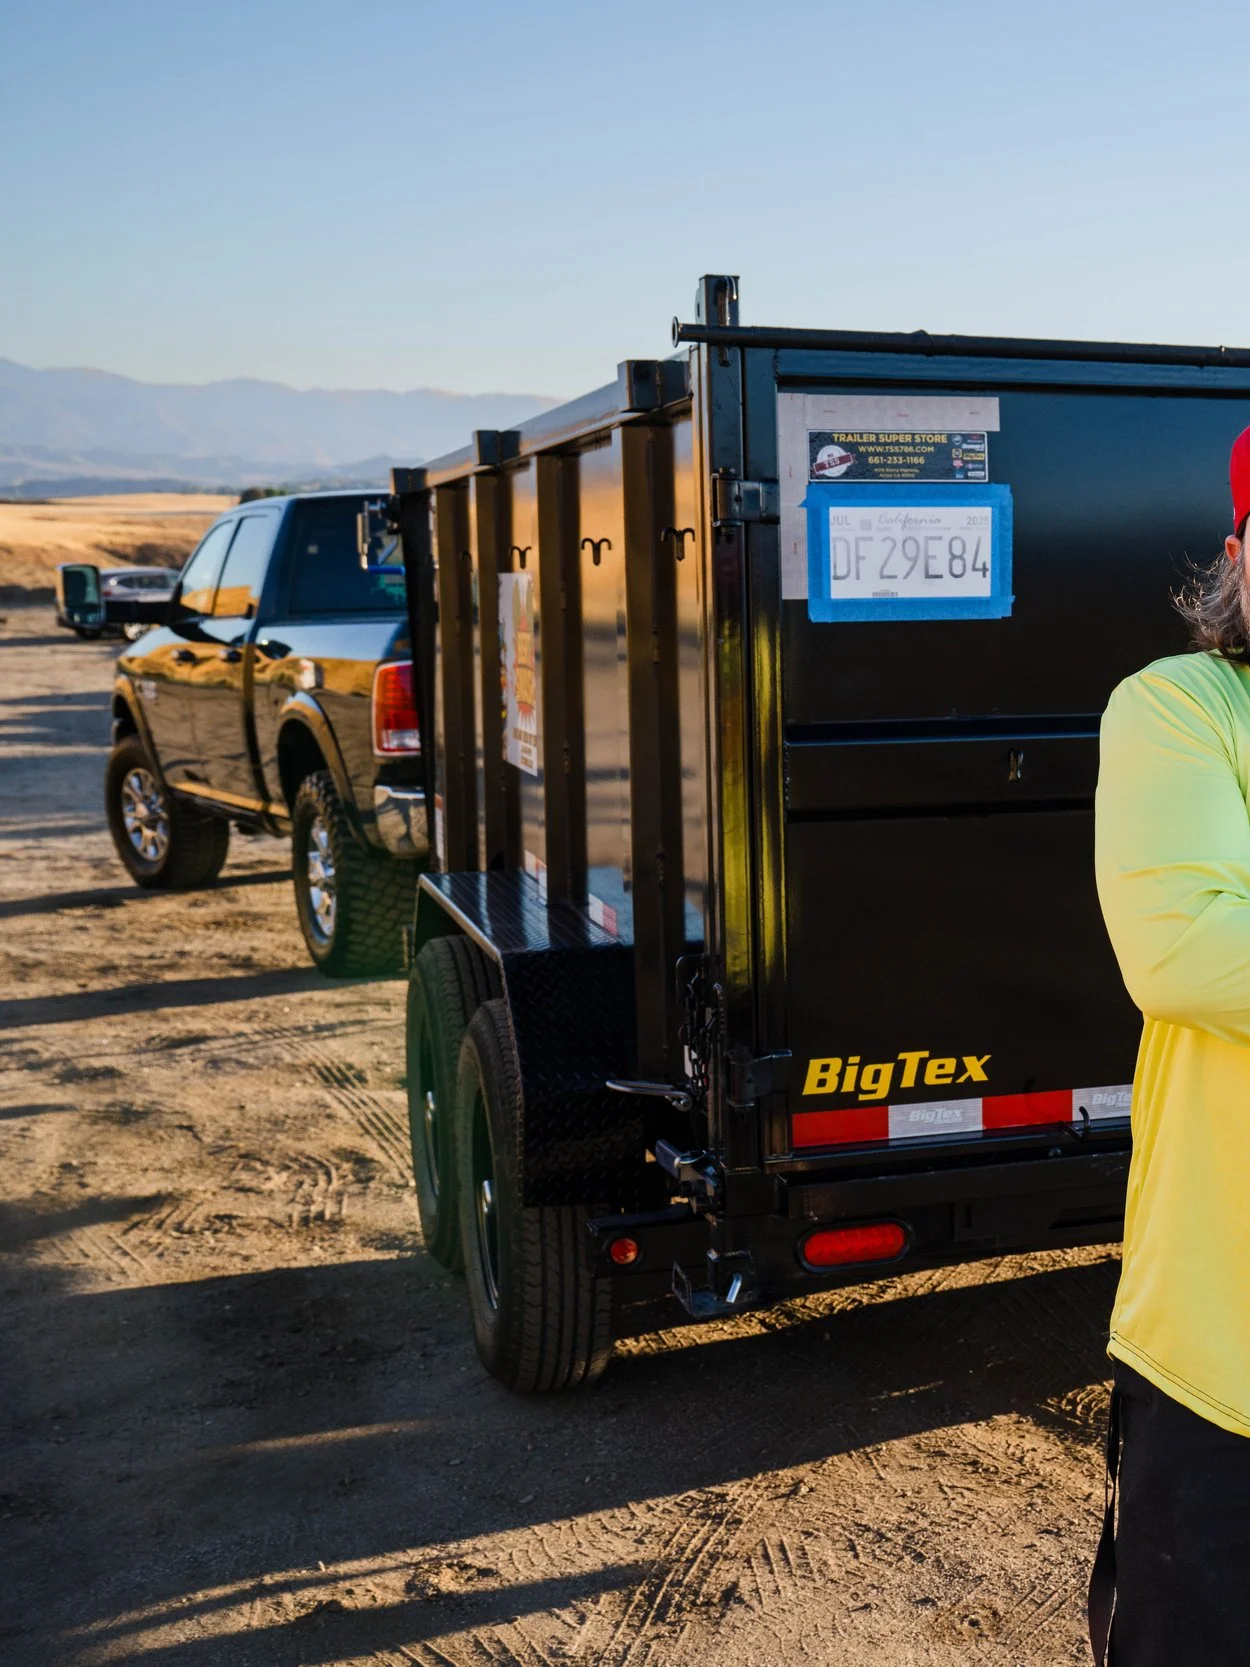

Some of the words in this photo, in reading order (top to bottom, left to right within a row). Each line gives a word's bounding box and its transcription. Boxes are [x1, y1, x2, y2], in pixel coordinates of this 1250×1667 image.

[832, 433, 876, 443] TRAILER
[879, 434, 912, 443] SUPER
[915, 434, 948, 443] STORE
[858, 445, 934, 453] WWW.TSS786.COM
[823, 457, 841, 468] TSS
[868, 456, 925, 464] 661-233-1166
[832, 515, 851, 526] JUL
[878, 511, 942, 531] California
[832, 535, 989, 581] DF29E84
[802, 1050, 992, 1101] BigTex
[909, 1108, 963, 1124] BigTex
